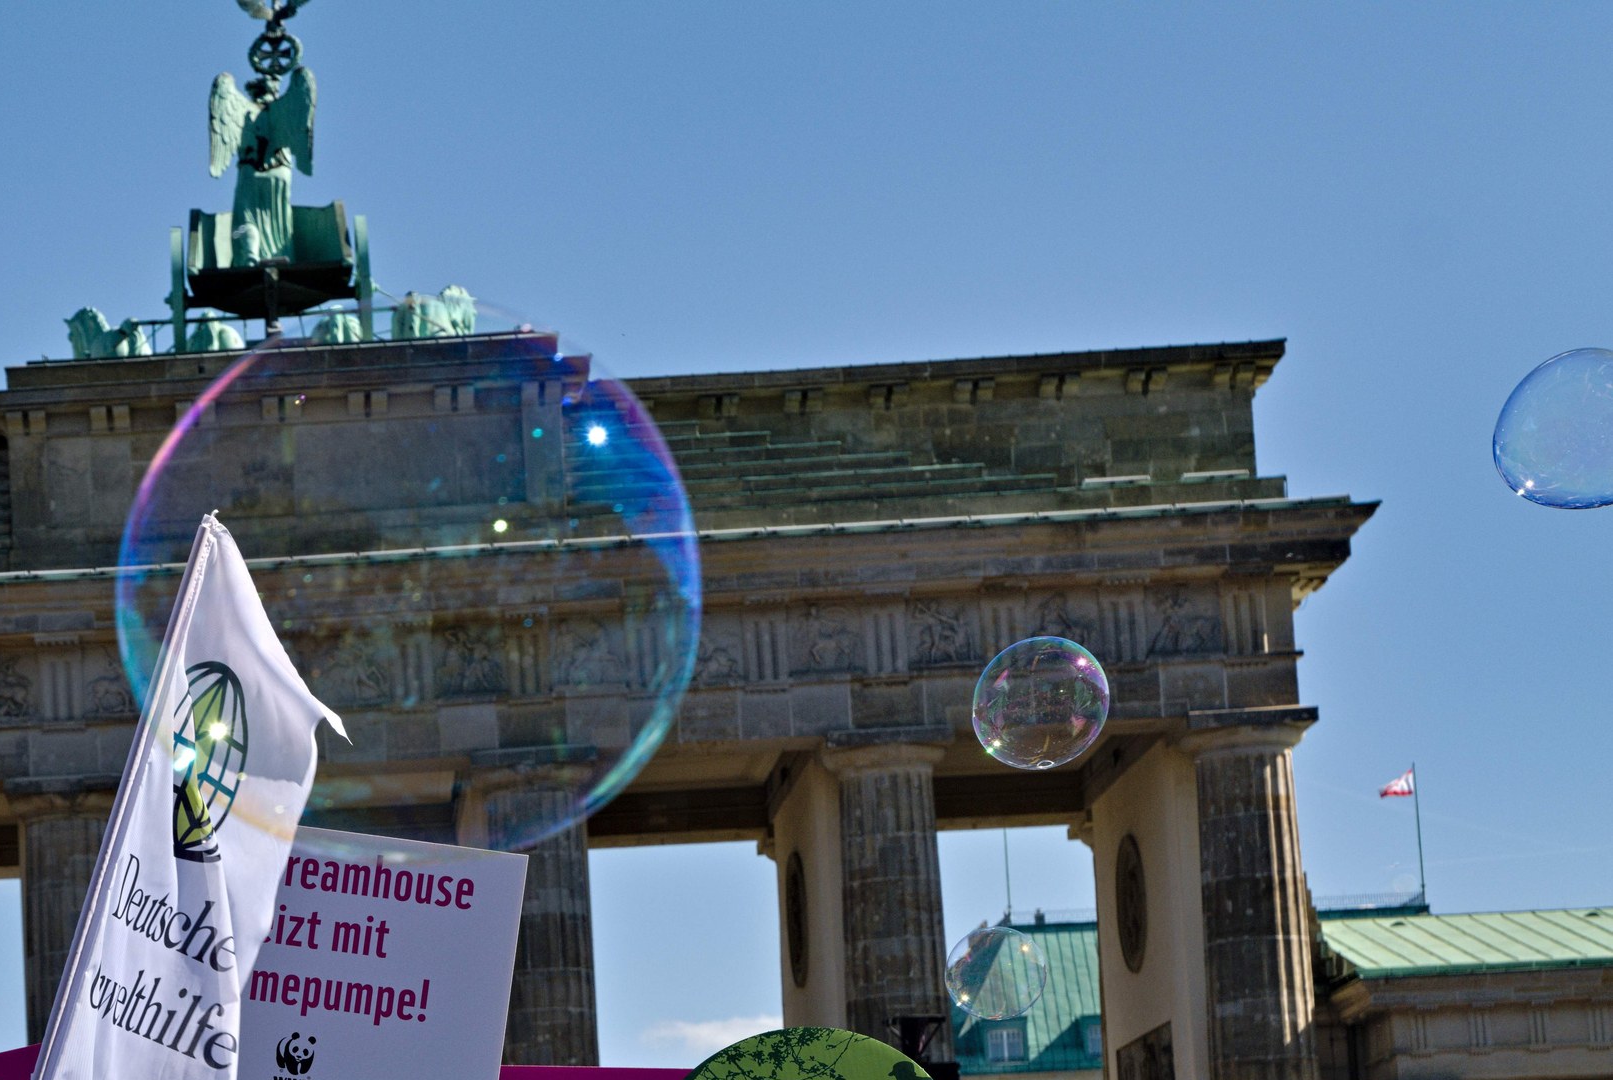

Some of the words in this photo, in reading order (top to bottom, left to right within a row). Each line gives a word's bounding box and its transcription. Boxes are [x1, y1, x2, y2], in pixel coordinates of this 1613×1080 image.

[285, 855, 475, 910] reamhouse
[112, 854, 236, 972] Deutsche
[263, 904, 322, 950] izt
[331, 915, 390, 958] mit
[249, 970, 430, 1026] mepumpe!
